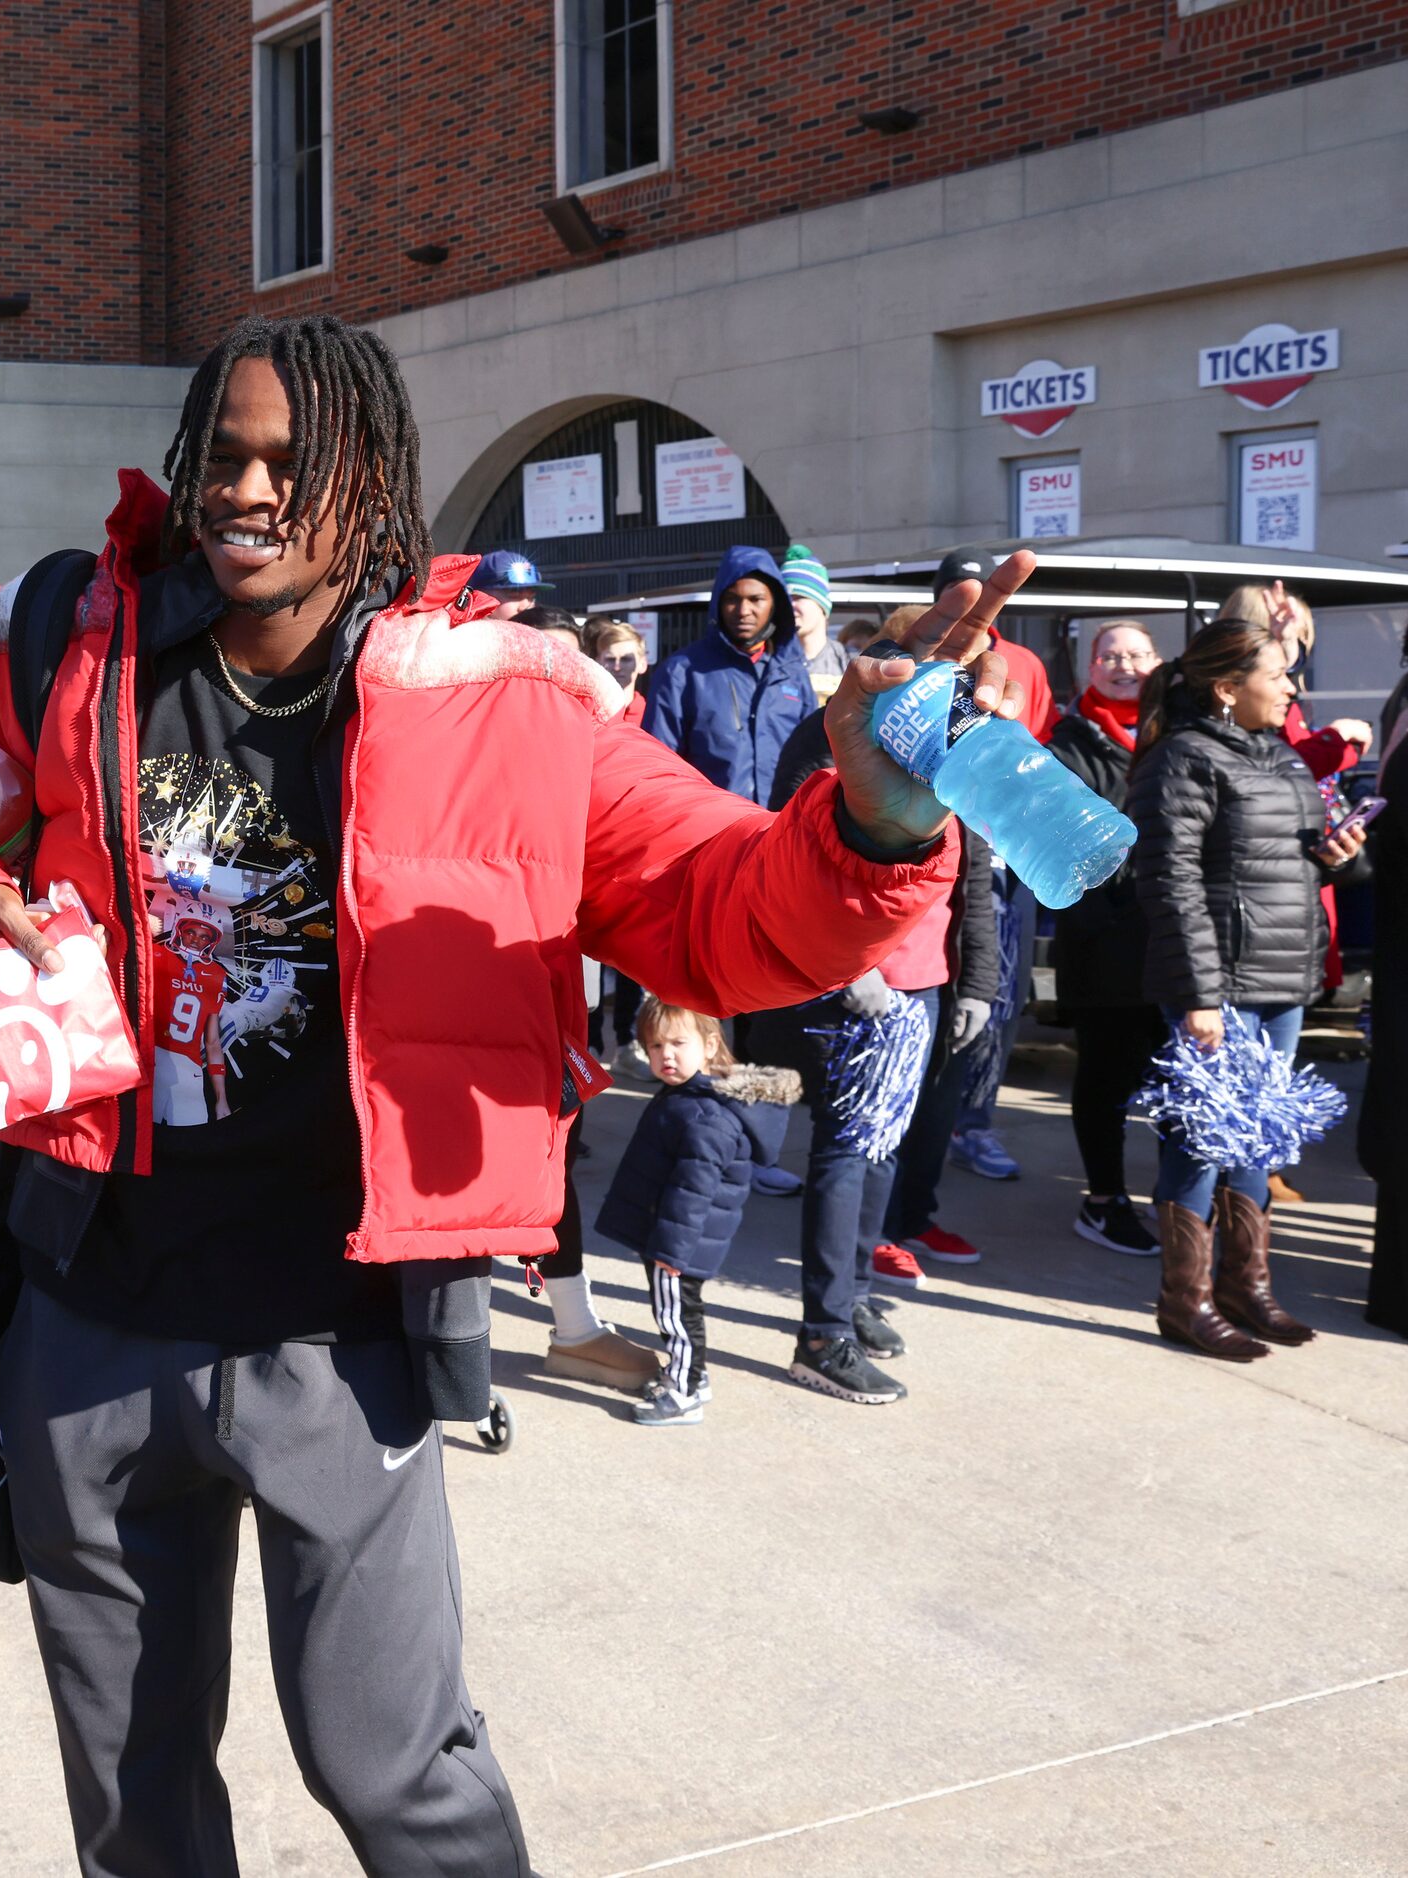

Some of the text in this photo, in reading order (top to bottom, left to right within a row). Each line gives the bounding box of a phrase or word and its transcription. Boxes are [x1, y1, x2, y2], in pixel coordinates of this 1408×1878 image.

[1208, 334, 1328, 382] TICKETS
[988, 372, 1087, 411] TICKETS
[1251, 448, 1304, 471] SMU
[1028, 472, 1072, 492] SMU
[878, 672, 948, 745] POWER
[950, 709, 982, 734] ELECTROLY
[961, 703, 977, 715] MO
[892, 710, 933, 759] ADE
[171, 978, 203, 993] SMU
[169, 992, 201, 1043] 9
